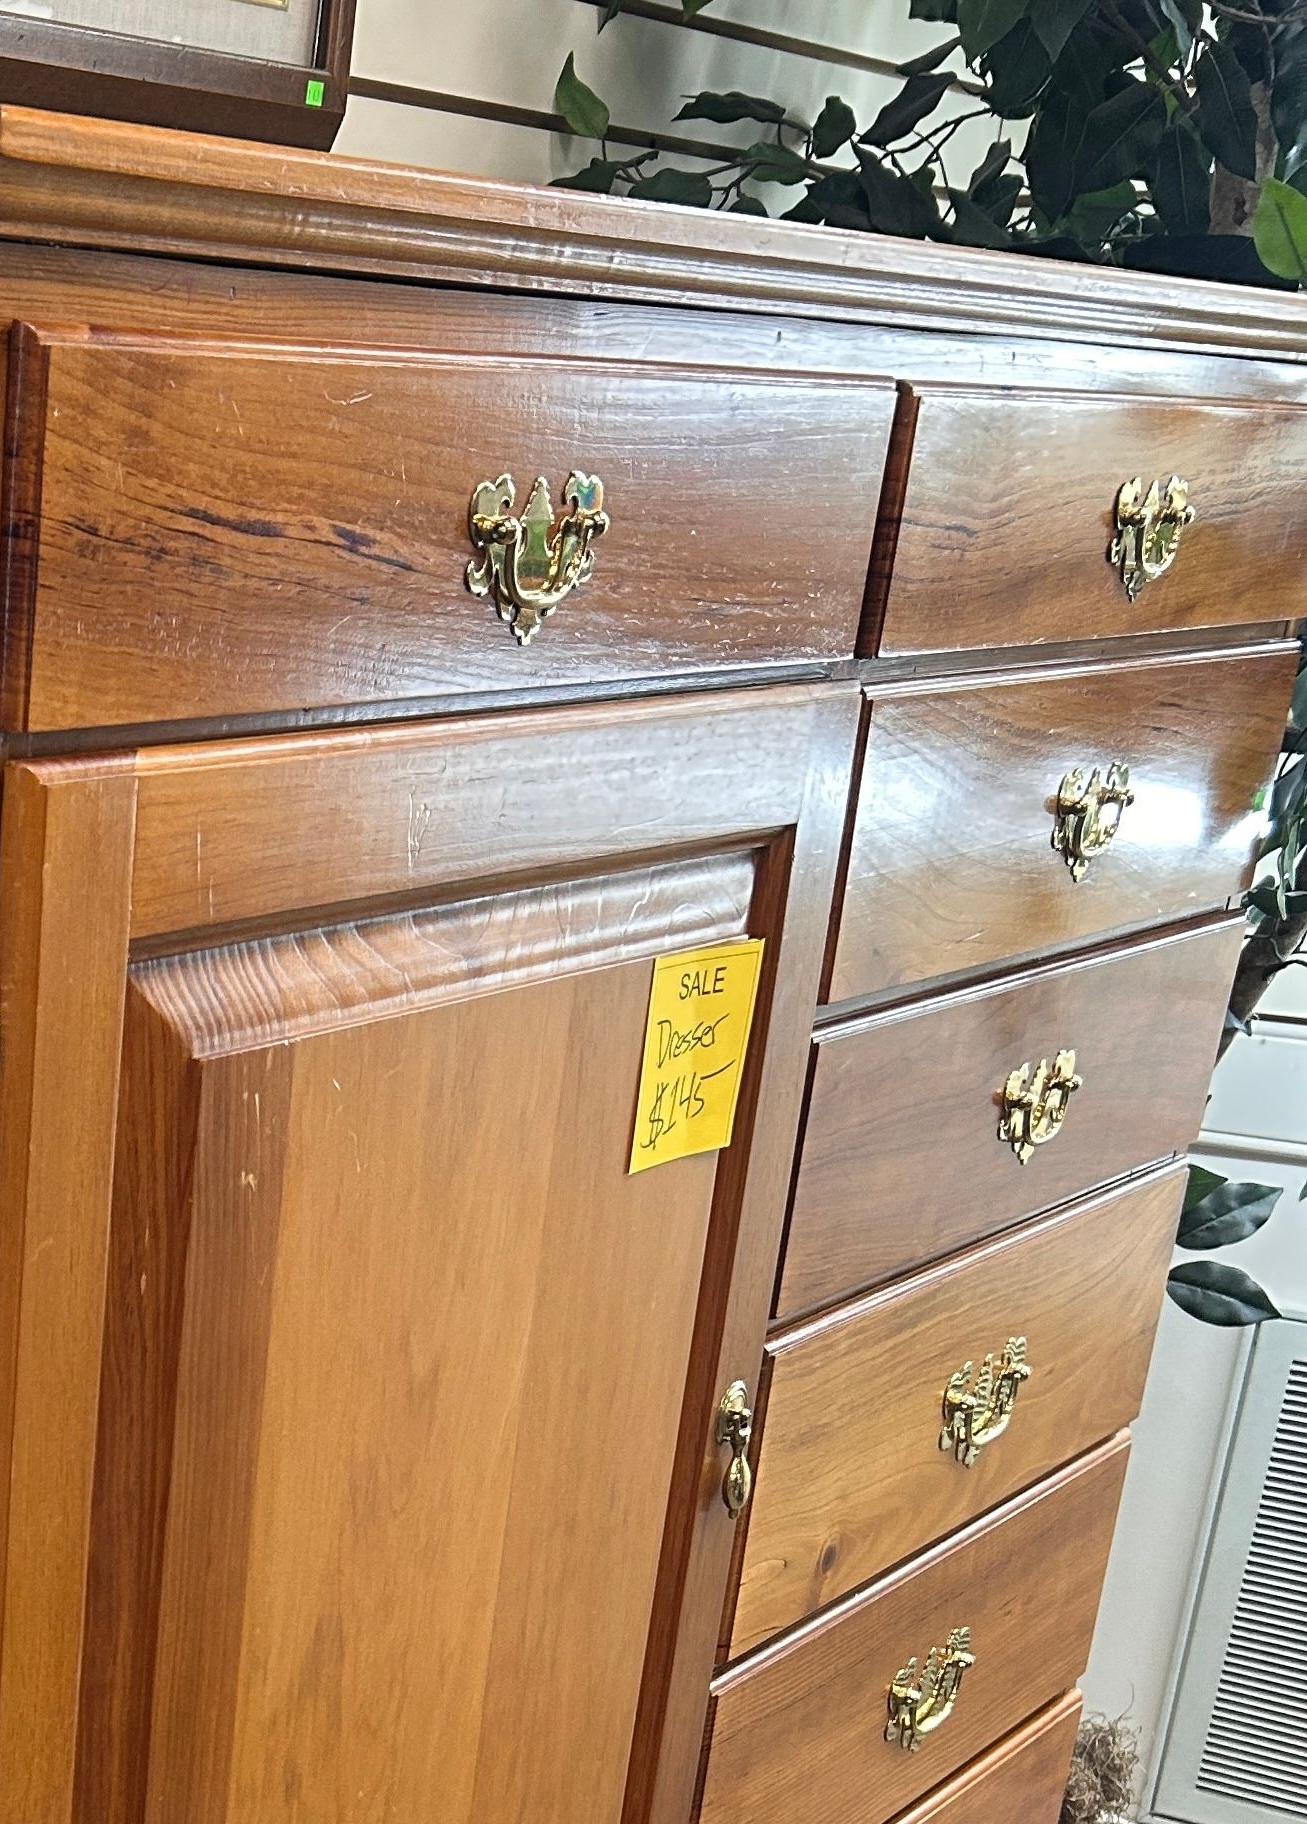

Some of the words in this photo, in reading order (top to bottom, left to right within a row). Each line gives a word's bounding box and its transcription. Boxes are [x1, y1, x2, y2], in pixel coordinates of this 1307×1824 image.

[678, 966, 727, 1001] SALE
[656, 1012, 730, 1069] Dresser
[640, 1059, 736, 1151] $145
